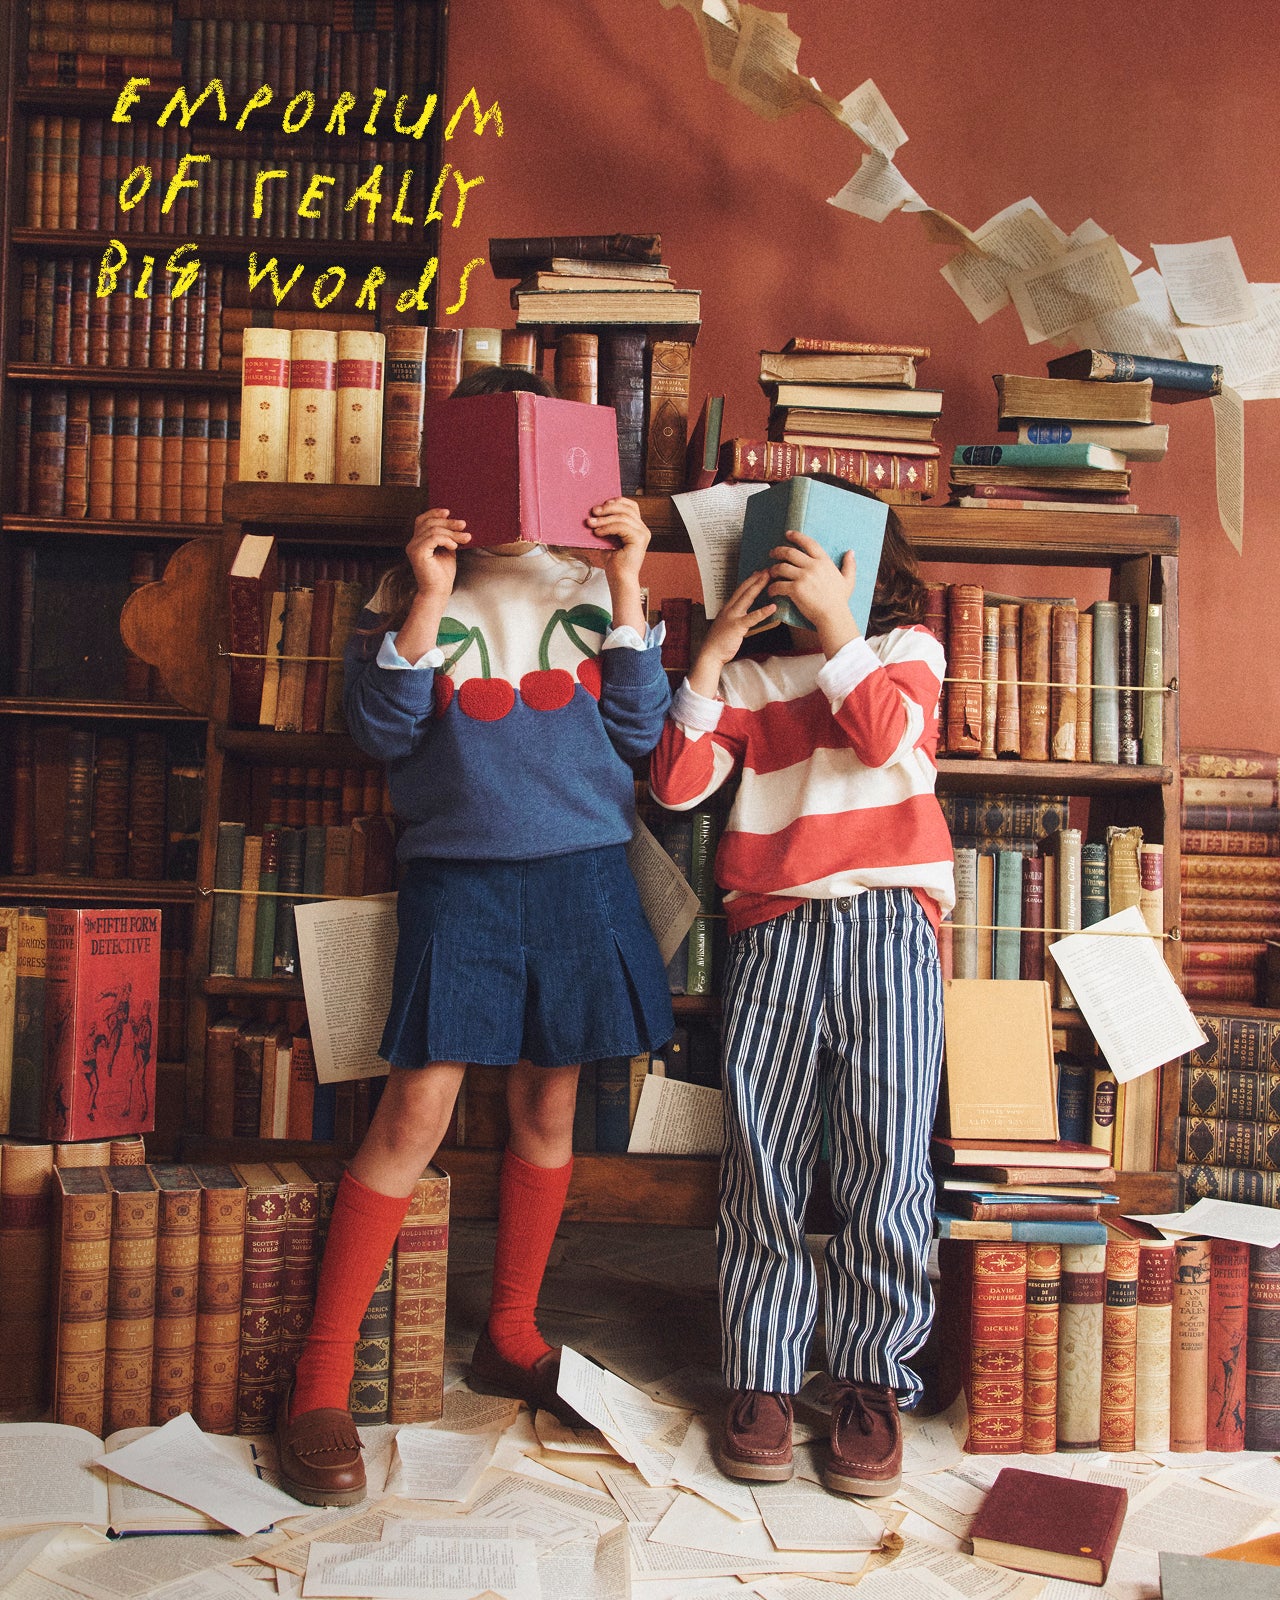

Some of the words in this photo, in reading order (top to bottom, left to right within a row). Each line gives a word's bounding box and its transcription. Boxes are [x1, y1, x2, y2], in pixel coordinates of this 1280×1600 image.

[21, 922, 35, 932] The
[130, 916, 158, 932] FORM
[91, 938, 152, 955] DETECTIVE
